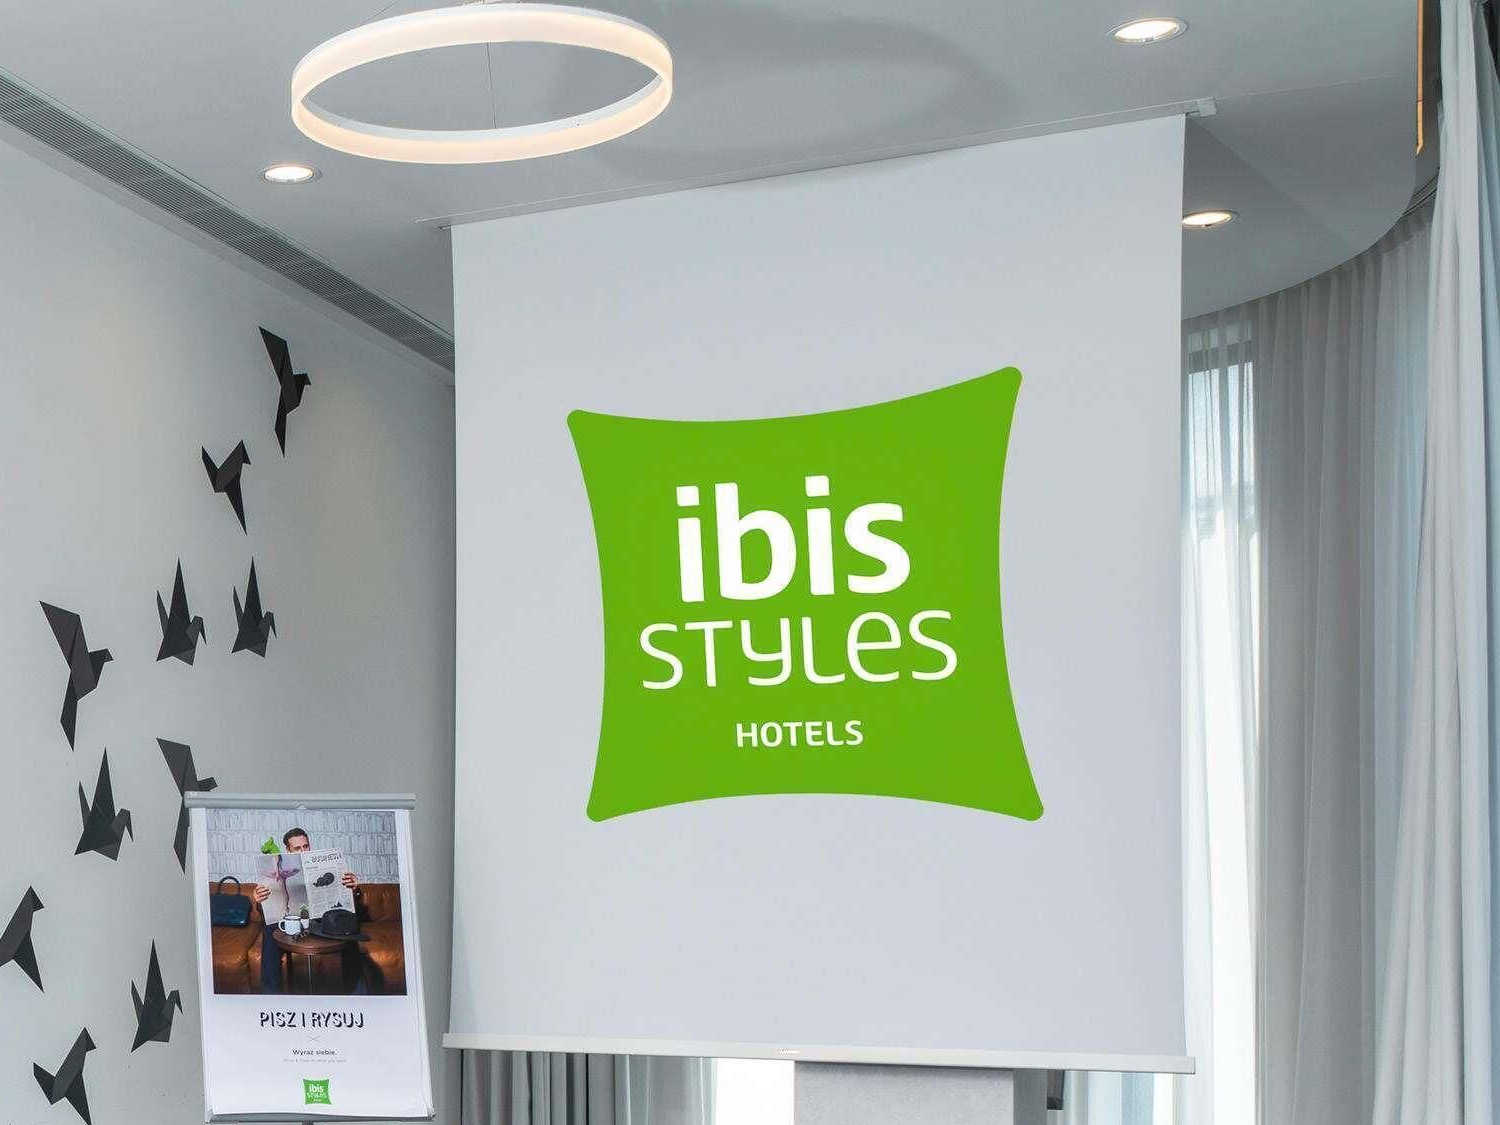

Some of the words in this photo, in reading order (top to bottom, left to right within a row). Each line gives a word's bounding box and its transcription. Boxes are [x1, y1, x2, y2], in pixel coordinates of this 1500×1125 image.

[676, 475, 911, 603] ibis
[736, 720, 864, 747] HOTELS
[260, 1011, 297, 1028] PISZ
[311, 1011, 364, 1028] RYSUJ
